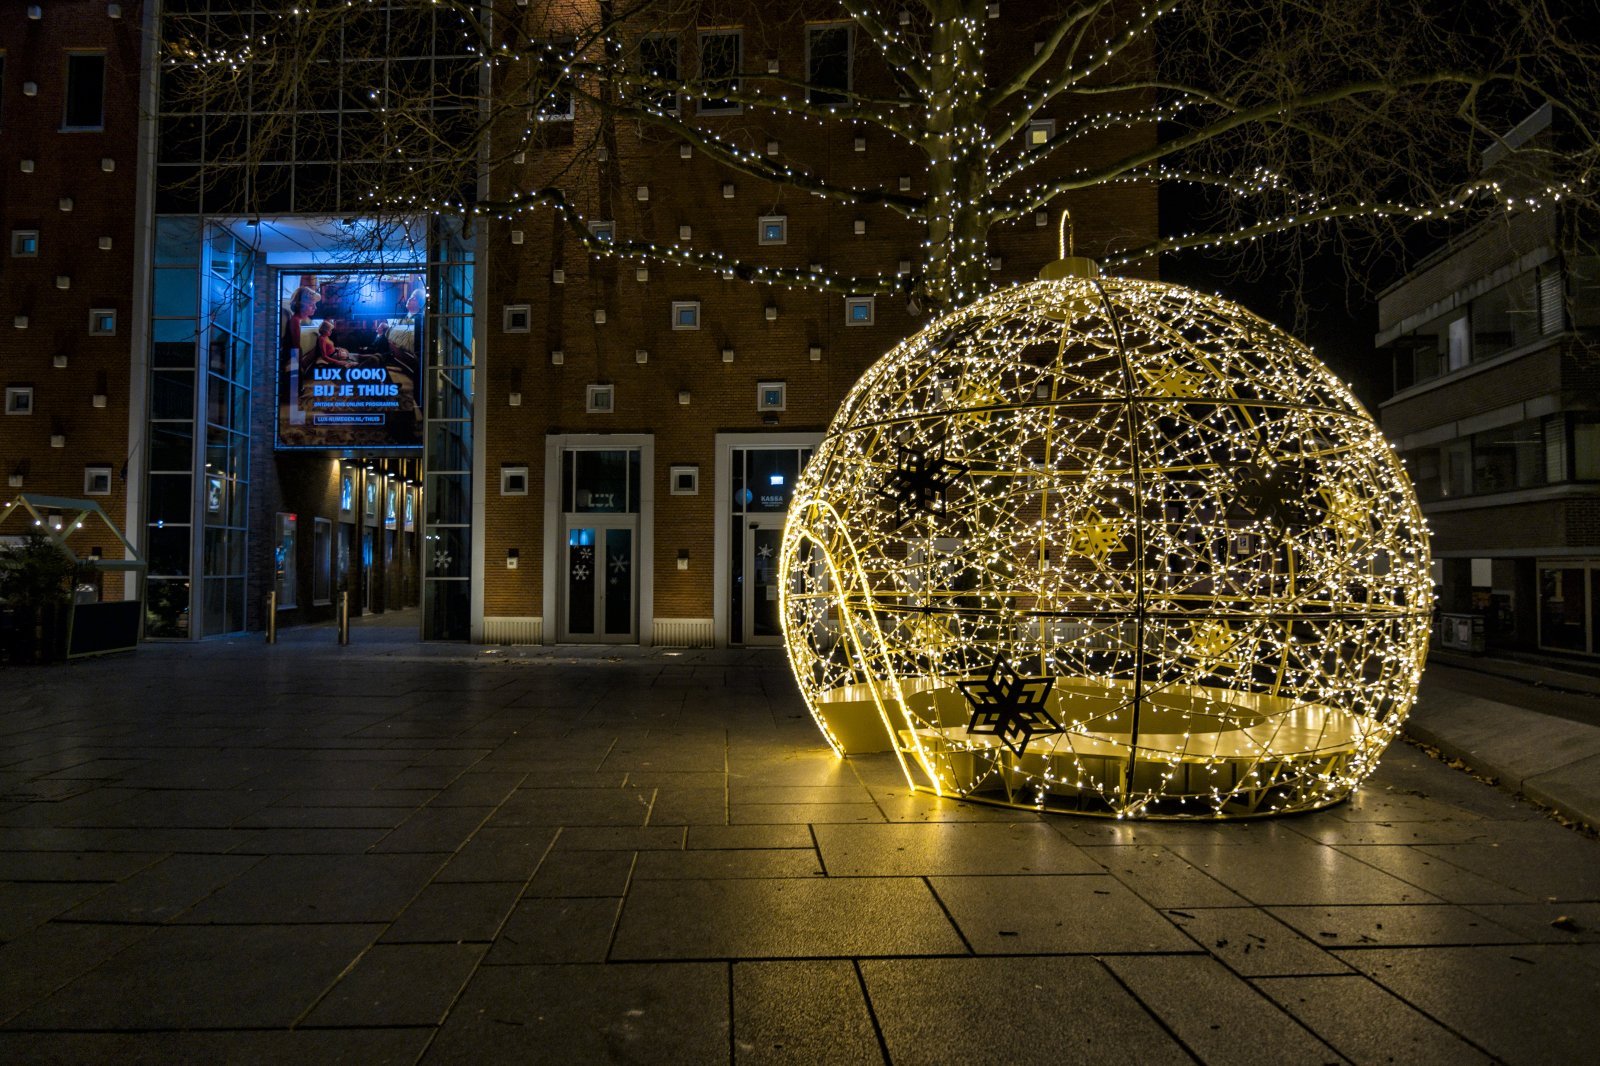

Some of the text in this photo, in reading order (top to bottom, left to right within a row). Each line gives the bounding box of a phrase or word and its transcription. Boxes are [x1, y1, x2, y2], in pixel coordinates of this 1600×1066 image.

[314, 368, 387, 382] LUX (OOK)
[314, 385, 399, 396] BIJ JE THUIS
